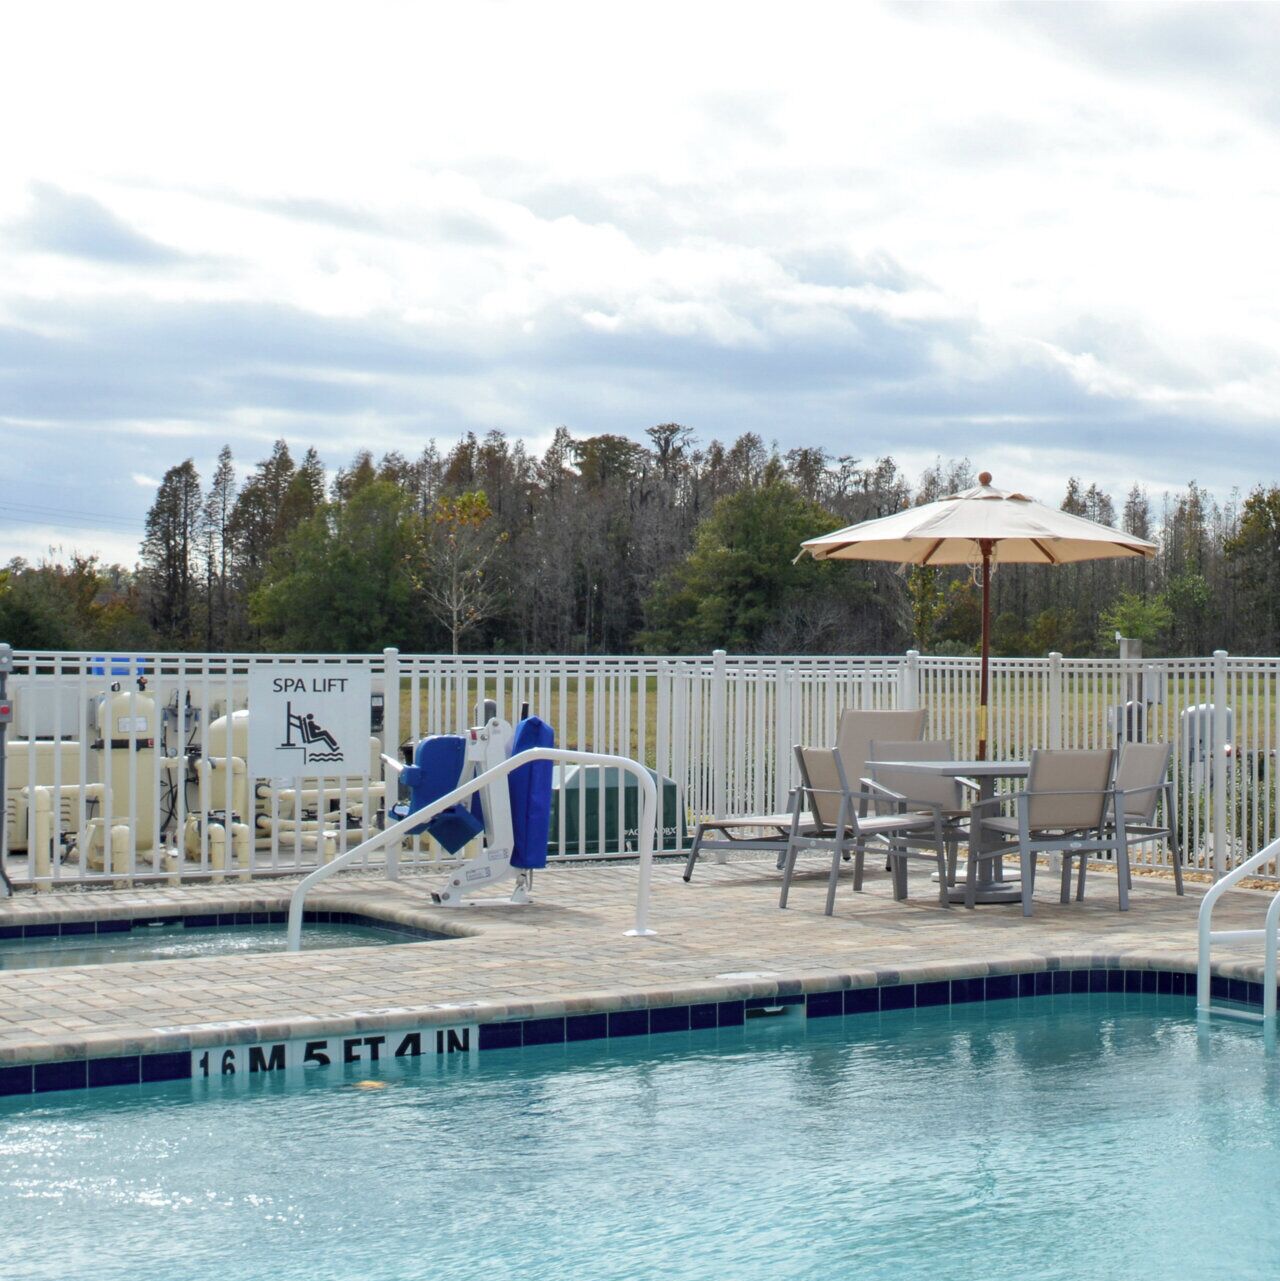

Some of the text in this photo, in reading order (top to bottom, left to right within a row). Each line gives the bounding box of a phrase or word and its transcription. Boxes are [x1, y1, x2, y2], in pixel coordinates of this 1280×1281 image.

[272, 678, 349, 693] SPA LIFT
[248, 1044, 286, 1073] M
[303, 1040, 331, 1066] 5
[343, 1035, 386, 1064] FT
[394, 1032, 426, 1057] 4
[436, 1027, 471, 1054] IN
